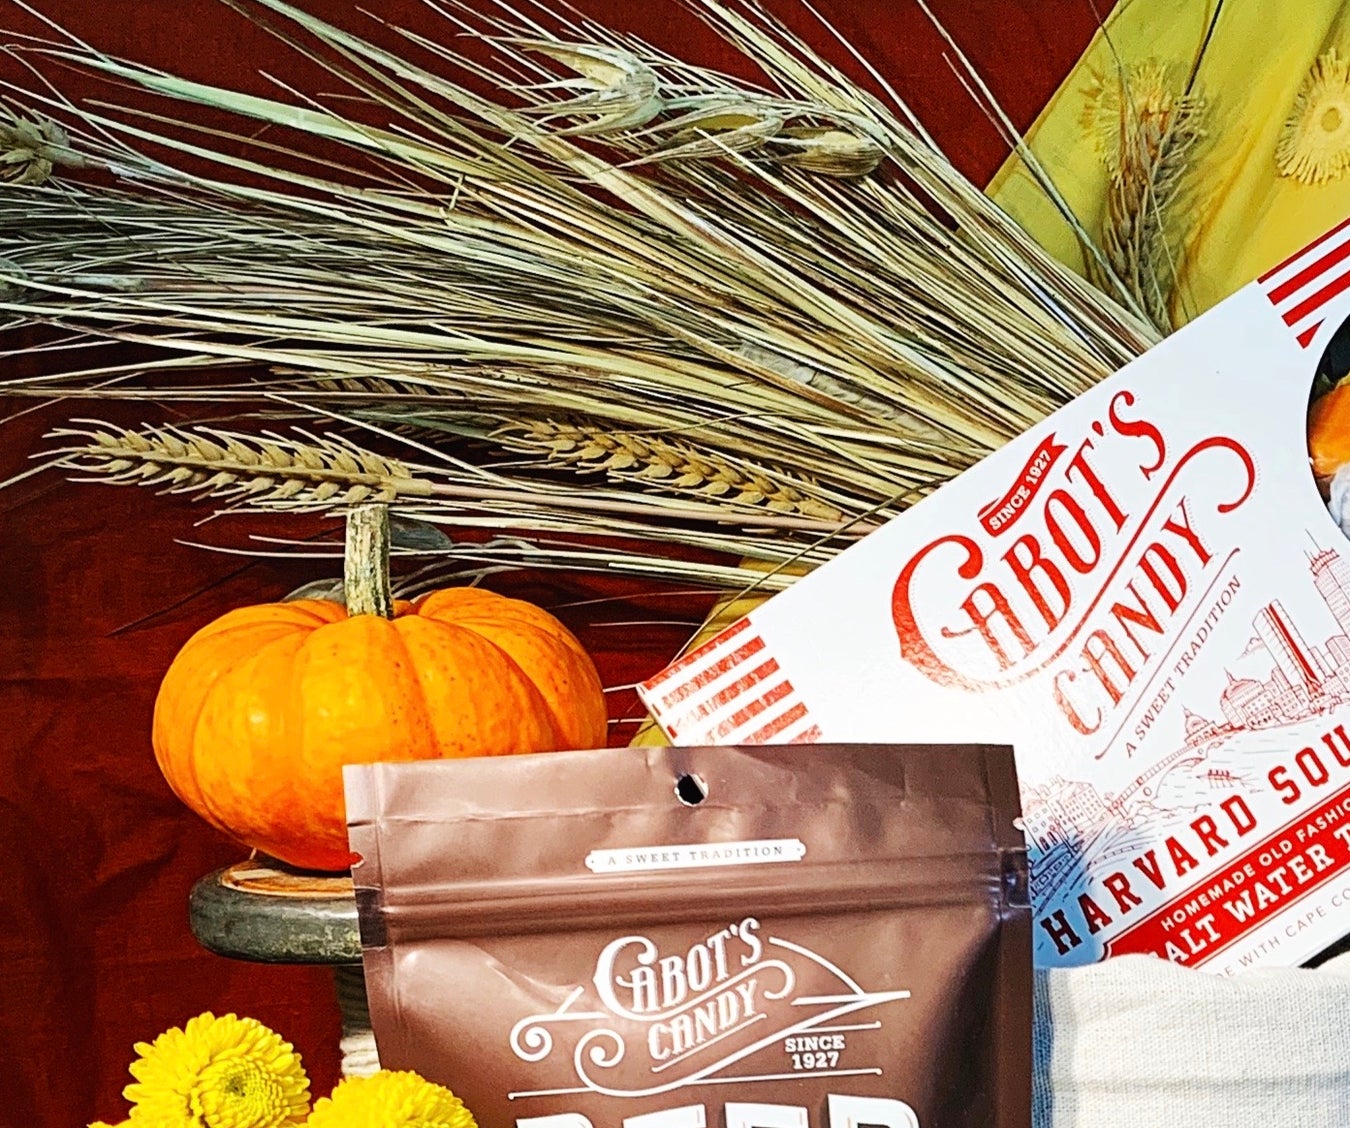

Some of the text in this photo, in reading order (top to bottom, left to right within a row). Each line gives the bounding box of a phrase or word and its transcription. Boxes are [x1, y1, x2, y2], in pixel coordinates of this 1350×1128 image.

[988, 449, 1052, 531] SINCE 1927
[891, 389, 1167, 693] CABOT'S
[1052, 496, 1214, 736] CANDY
[1125, 574, 1242, 759] A SWEET TRADITION
[608, 846, 784, 866] A SWEET TRADITION
[1041, 794, 1258, 955] HARVARD
[1160, 863, 1256, 931] HOMEMADE
[1258, 839, 1293, 867] OLD
[1149, 912, 1222, 963] ALT
[1222, 843, 1335, 924] WATER
[1238, 936, 1281, 969] WITH
[1285, 904, 1327, 939] CAPE
[592, 916, 764, 1019] CABOT'S
[648, 979, 760, 1061] CANDY
[784, 1034, 847, 1053] SINCE
[791, 1050, 840, 1071] 1927
